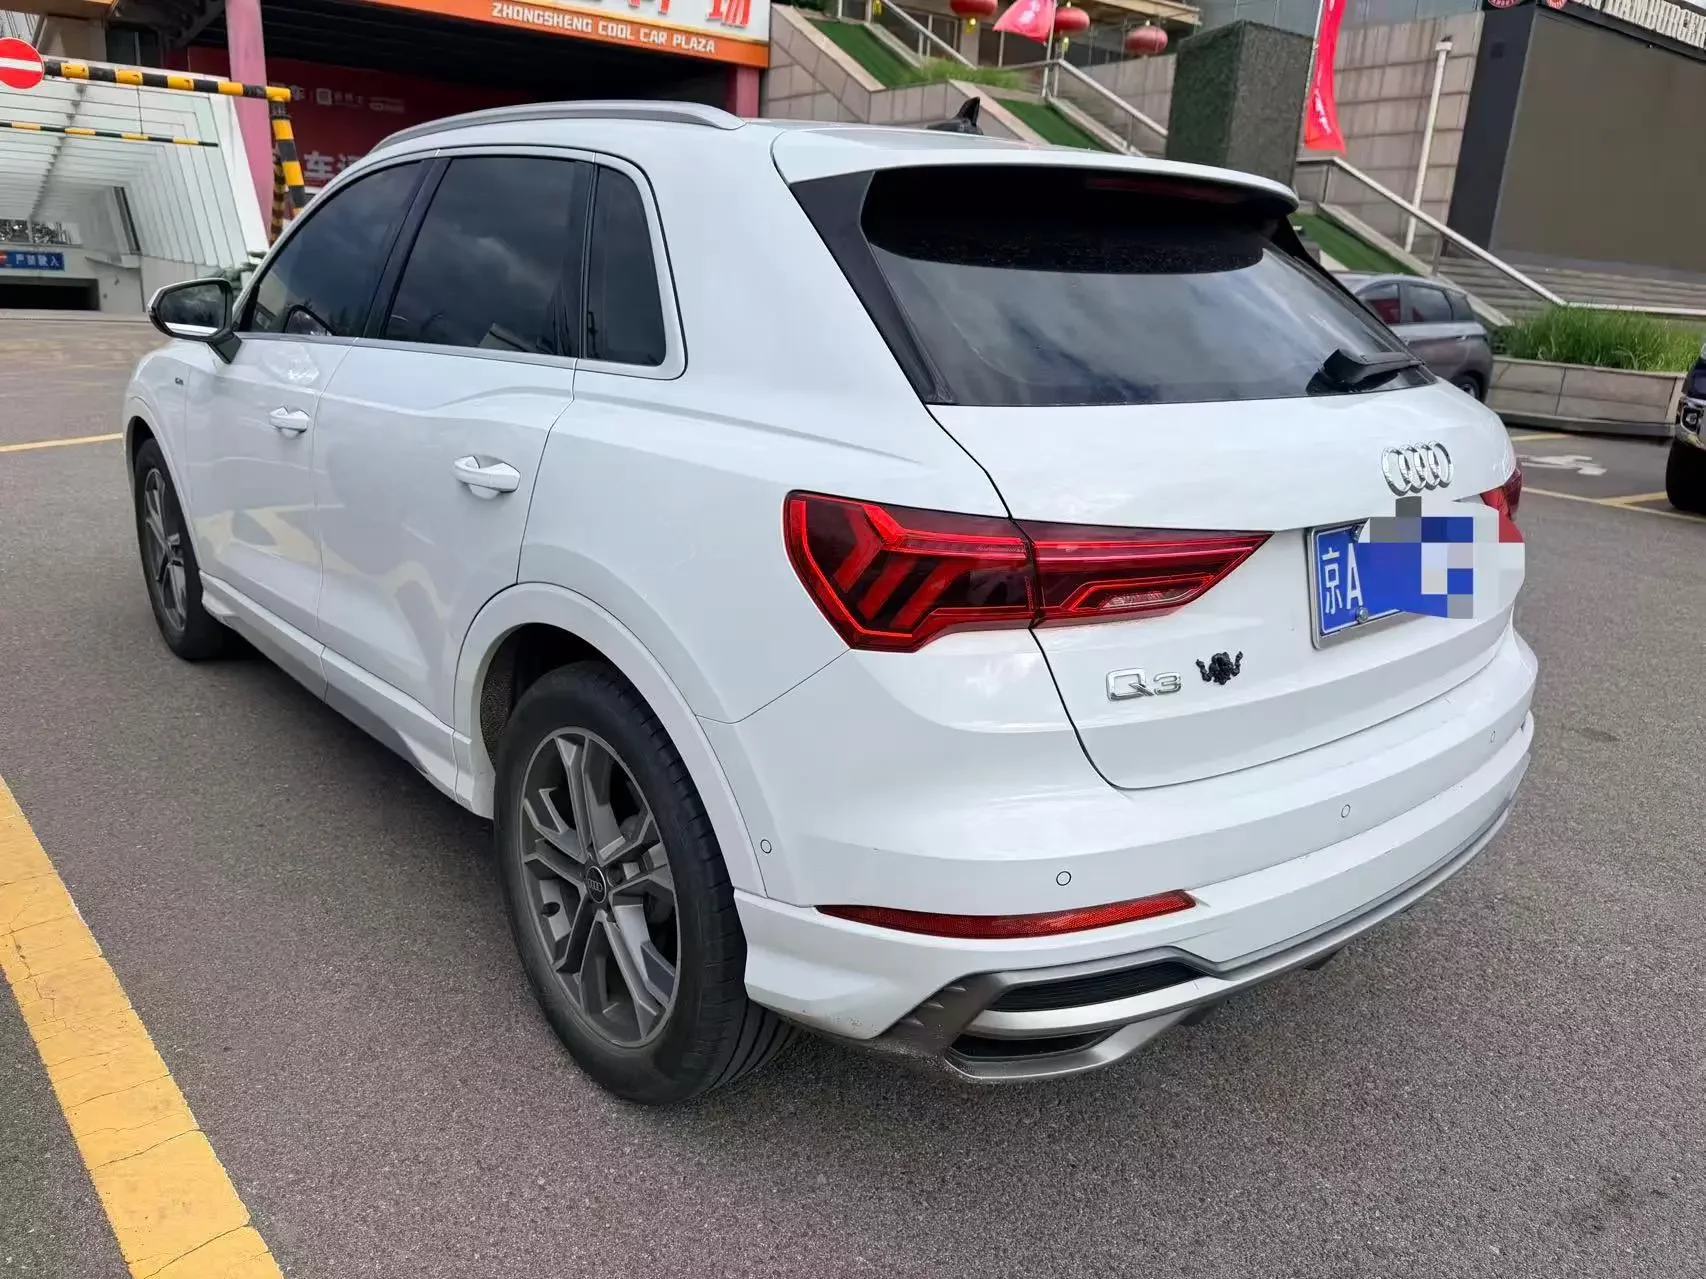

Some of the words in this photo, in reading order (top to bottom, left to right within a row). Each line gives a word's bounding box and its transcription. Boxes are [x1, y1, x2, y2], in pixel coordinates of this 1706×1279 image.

[491, 2, 593, 33] ZHONGSHENG
[598, 20, 635, 40] COOL
[639, 28, 668, 44] CAR
[672, 34, 716, 54] PLAZA
[1105, 667, 1182, 702] Q3
